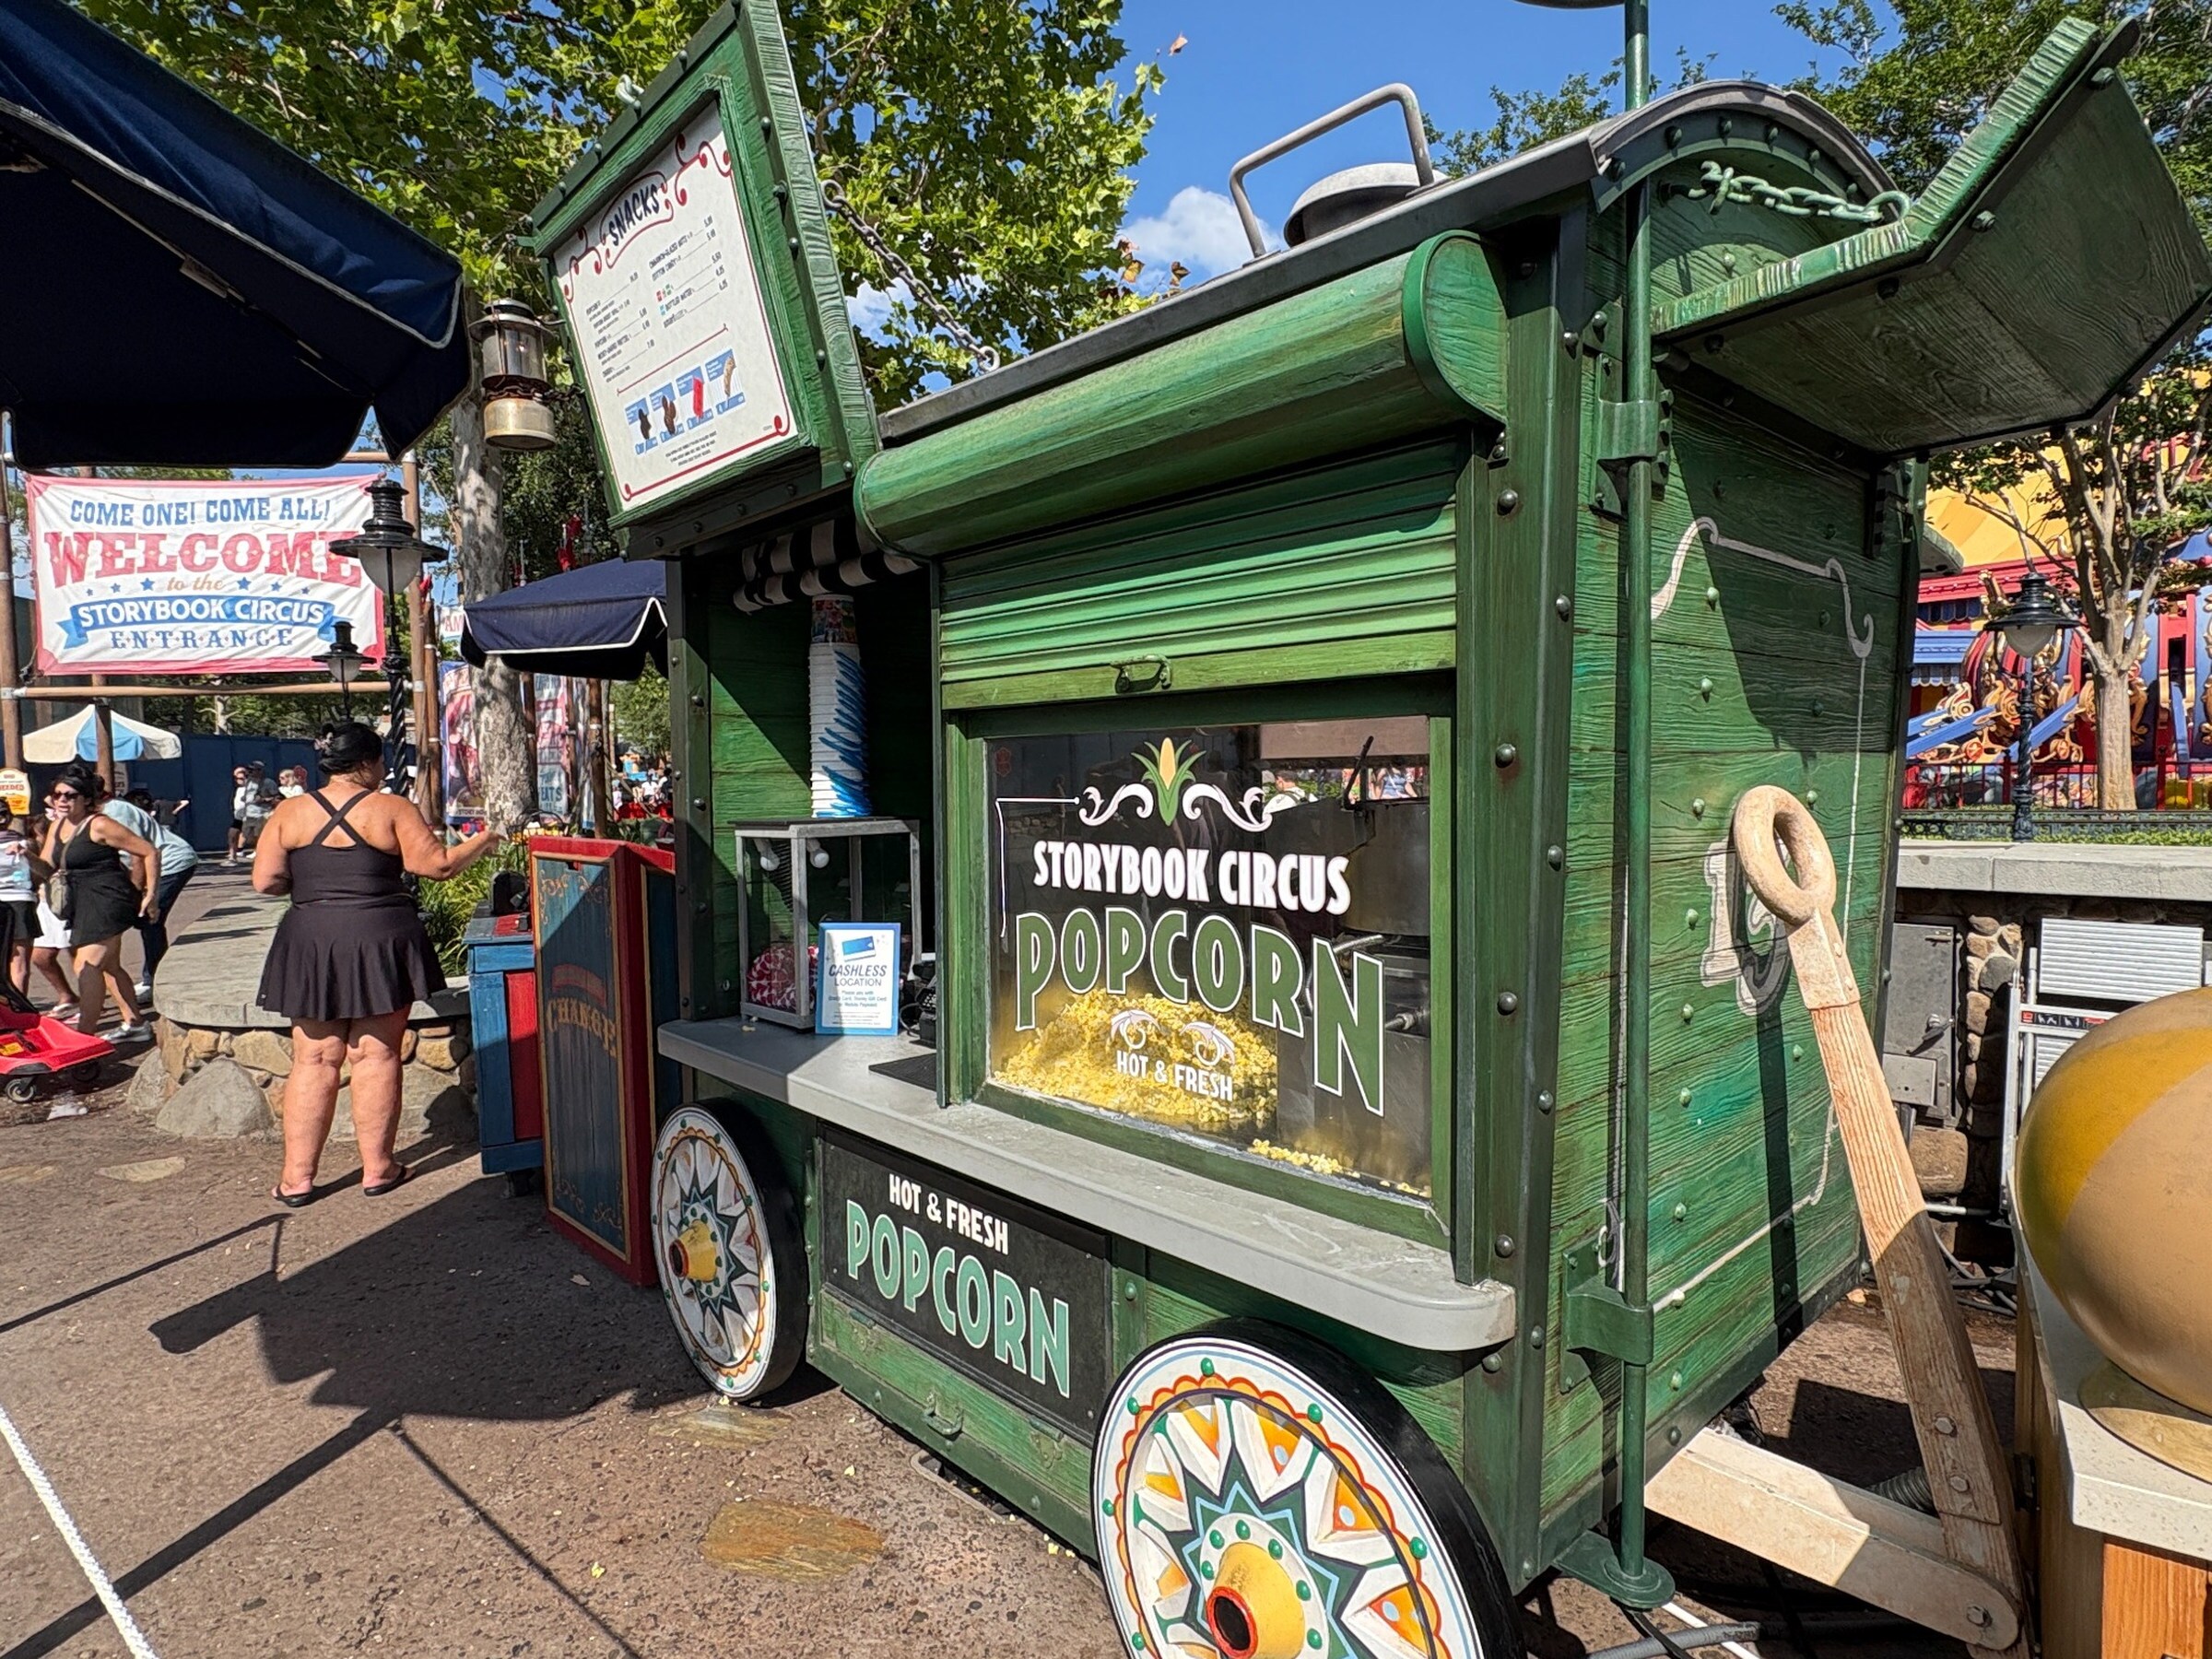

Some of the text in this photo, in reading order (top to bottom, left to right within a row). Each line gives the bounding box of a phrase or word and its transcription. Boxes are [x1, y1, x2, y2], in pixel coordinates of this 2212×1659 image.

[607, 183, 661, 246] SNACKS
[71, 497, 331, 526] COME ONE! COME ALL!
[44, 531, 361, 588] WELCOME
[166, 574, 225, 592] to the
[77, 598, 326, 627] STORYBOOK CIRCUS
[110, 628, 293, 650] ENTRANCE
[1033, 840, 1351, 915] STORYBOOK CIRCUS
[829, 964, 888, 977] CASHLESS
[834, 978, 882, 986] LOCATION
[1015, 907, 1384, 1117] POPCORN
[1116, 1050, 1233, 1101] HOT & FRESH
[889, 1173, 1008, 1255] HOT & FRESH
[846, 1199, 1070, 1399] POPCORN
